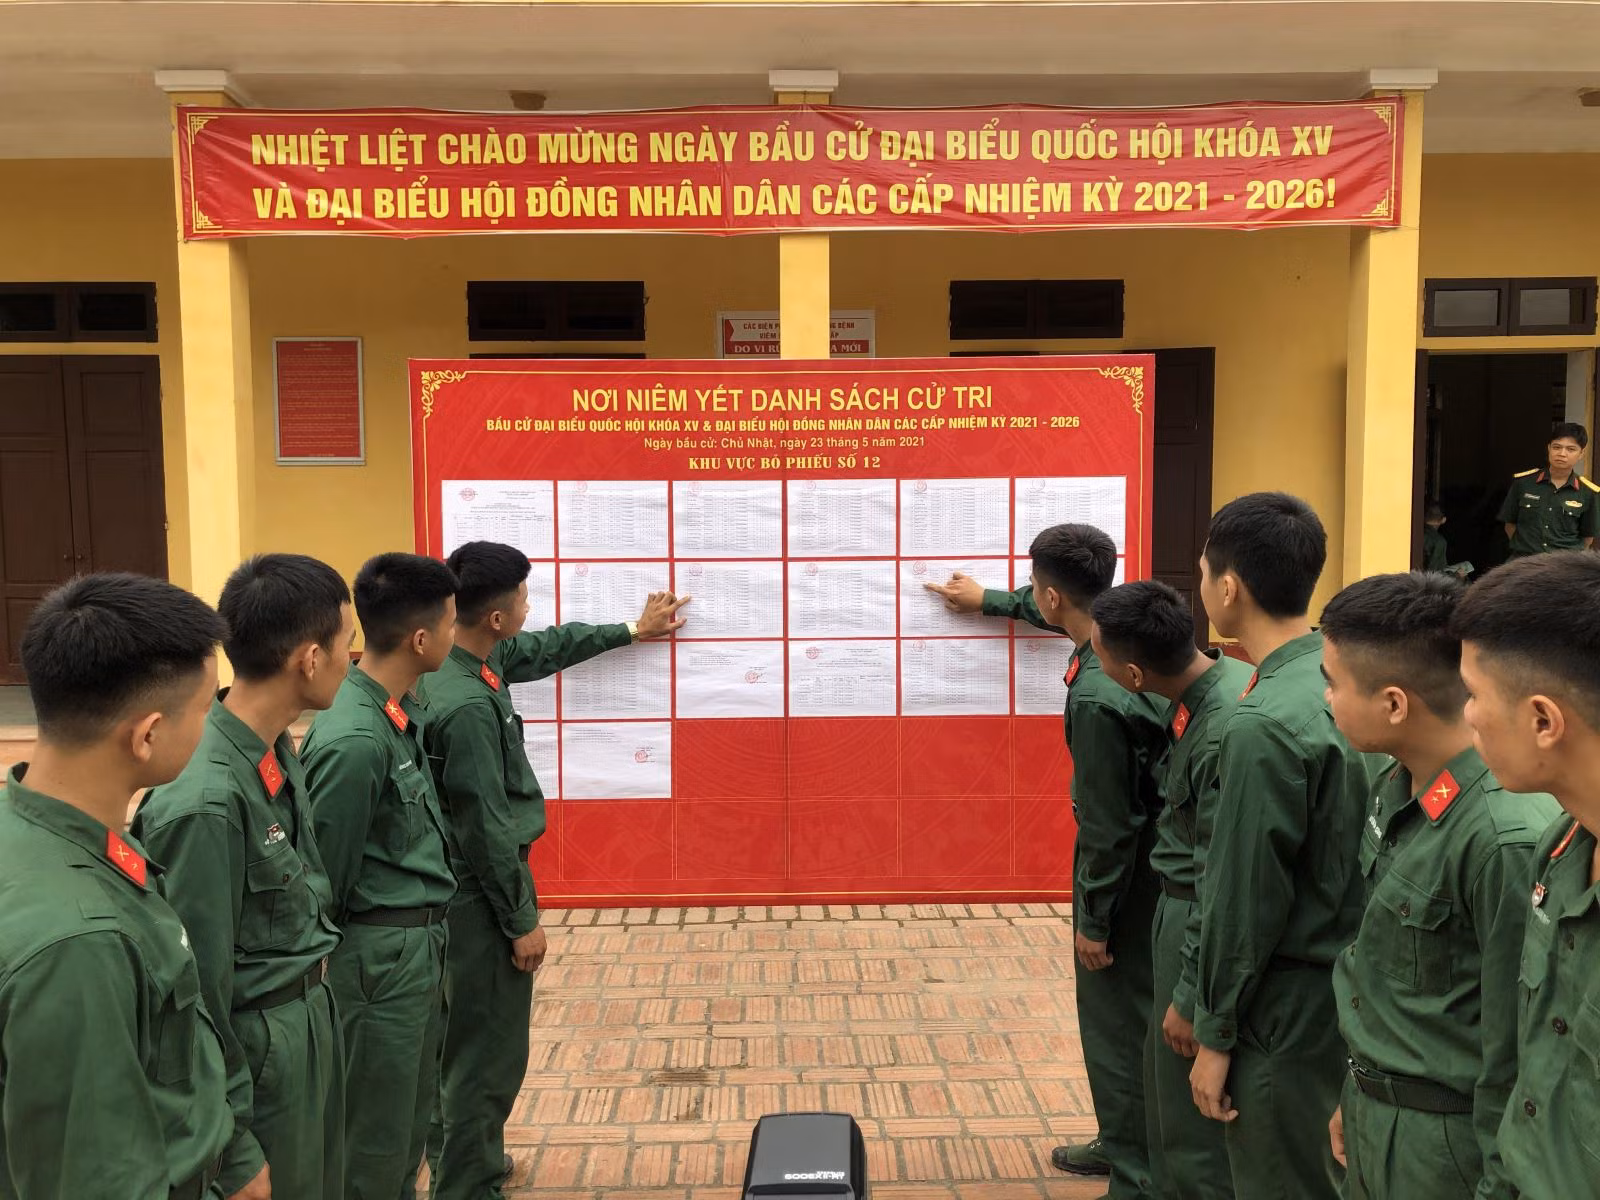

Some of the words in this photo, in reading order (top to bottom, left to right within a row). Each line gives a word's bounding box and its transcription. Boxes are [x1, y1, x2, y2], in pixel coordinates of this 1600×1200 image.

[251, 128, 348, 172] NHIỆT
[360, 128, 426, 172] LIỆT
[438, 128, 526, 164] CHÀO
[538, 127, 638, 164] MỪNG
[649, 125, 738, 163] NGÀY
[749, 120, 814, 162] BẦU
[826, 120, 874, 162] CỬ
[880, 126, 935, 168] ĐẠI
[946, 117, 1020, 161] BIỂU
[1031, 120, 1118, 164] QUỐC
[1129, 123, 1183, 165] HỘI
[1194, 122, 1281, 158] KHÓA
[1292, 124, 1333, 158] XV
[253, 181, 298, 219] VÀ
[306, 187, 363, 225] ĐẠI
[375, 176, 450, 218] BIỂU
[461, 181, 516, 225] HỘI
[526, 176, 618, 217] ĐỒNG
[629, 179, 722, 216] NHÂN
[733, 178, 801, 216] DÂN
[812, 177, 878, 215] CÁC
[888, 173, 955, 214] CẤP
[965, 177, 1071, 219] NHIỆM
[1083, 175, 1124, 213] KỲ
[1134, 181, 1209, 211] 2021
[1246, 178, 1336, 209] 2026!
[734, 344, 751, 353] DO
[573, 388, 618, 412] NƠI
[626, 382, 688, 412] NIÊM
[695, 384, 743, 412] YẾT
[751, 388, 821, 412] DANH
[829, 382, 899, 411] SÁCH
[907, 382, 946, 410] CỬ
[952, 385, 992, 408] TRI
[514, 416, 533, 432] CỬ
[534, 419, 555, 434] ĐẠI
[558, 416, 586, 432] BIỂU
[589, 416, 622, 433] QUỐC
[624, 418, 645, 434] HỘI
[648, 418, 680, 432] KHÓA
[684, 420, 699, 432] XV
[702, 420, 712, 432] &
[715, 420, 736, 434] ĐẠI
[739, 416, 767, 432] BIỂU
[770, 417, 790, 434] HỘI
[828, 416, 863, 431] NHÂN
[865, 416, 891, 430] DÂN
[893, 416, 918, 430] CÁC
[921, 414, 945, 430] CẤP
[948, 414, 988, 431] NHIỆM
[1010, 416, 1038, 428] 2021
[1050, 416, 1080, 428] 2026
[644, 437, 673, 451] Ngày
[721, 436, 744, 449] Chủ
[747, 437, 777, 450] Nhật,
[780, 437, 807, 450] ngày
[810, 437, 824, 448] 23
[827, 437, 859, 449] tháng
[862, 437, 869, 447] 5
[872, 437, 896, 447] năm
[899, 436, 925, 447] 2021
[688, 457, 721, 470] KHU
[726, 456, 756, 472] VỰC
[786, 453, 832, 469] PHIẾU
[837, 452, 858, 469] SỐ
[863, 456, 881, 469] 12
